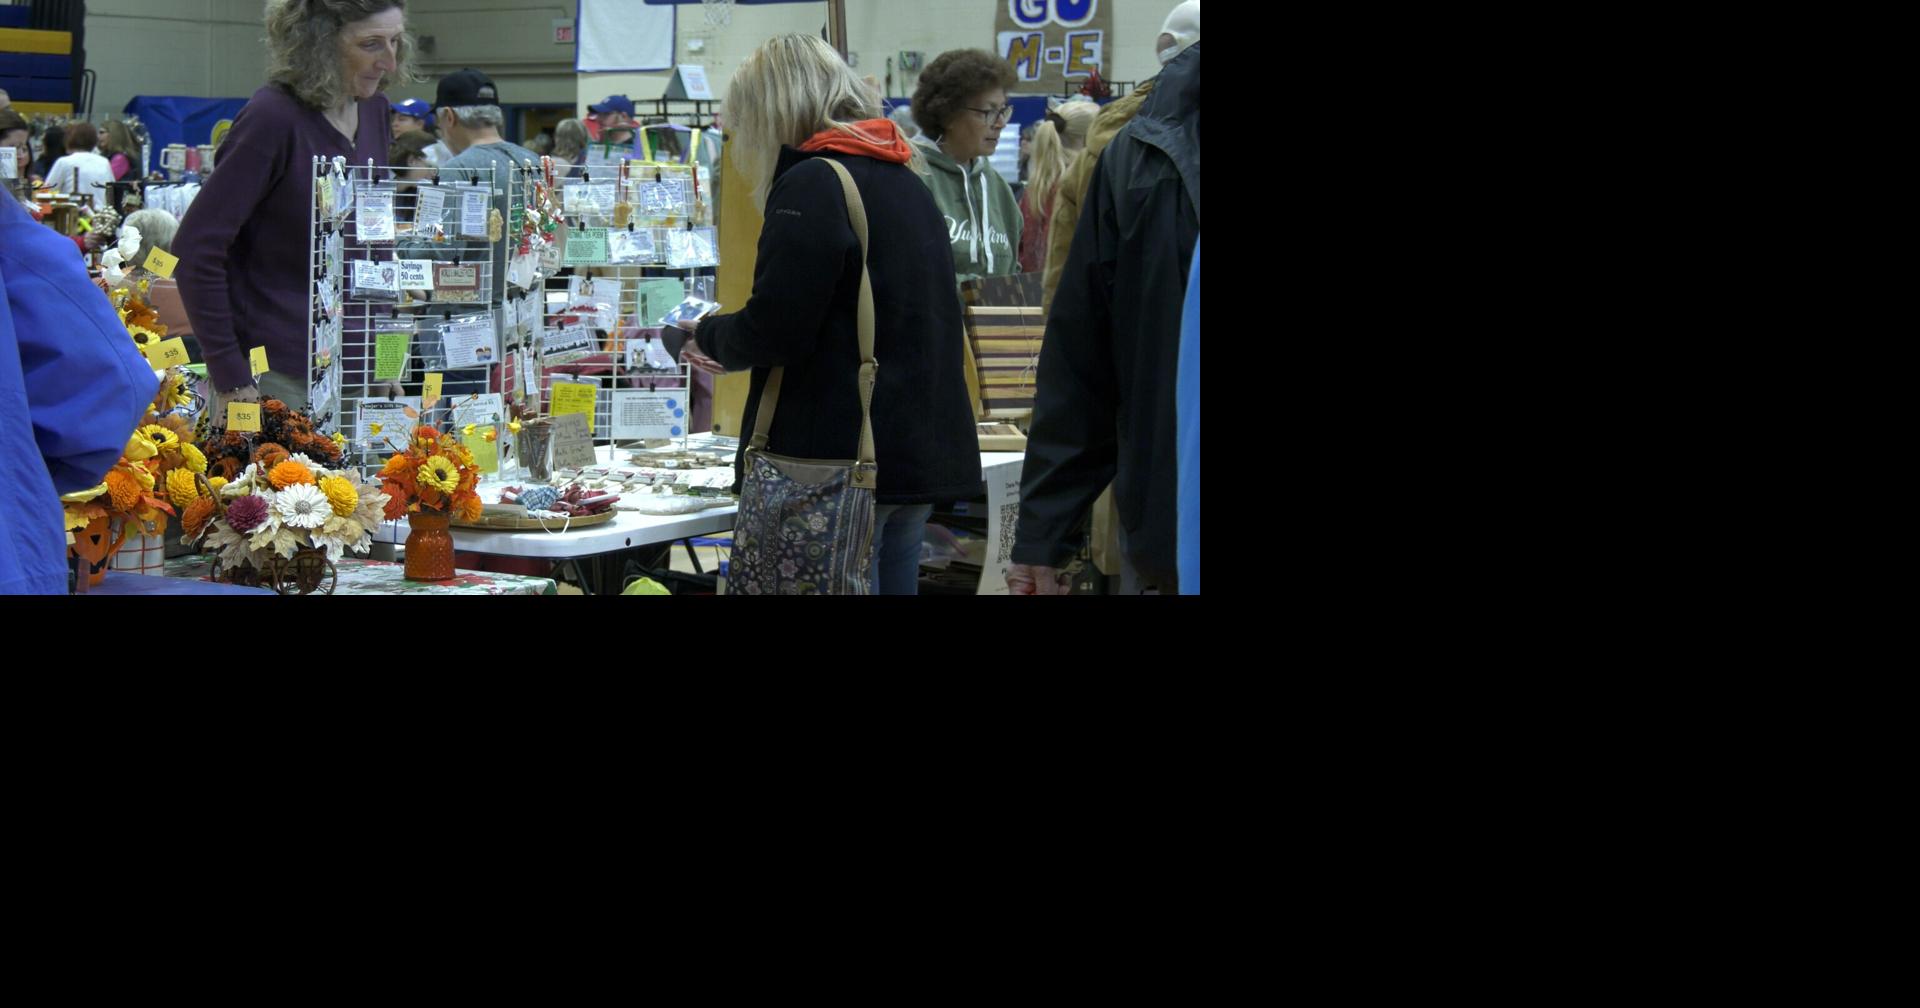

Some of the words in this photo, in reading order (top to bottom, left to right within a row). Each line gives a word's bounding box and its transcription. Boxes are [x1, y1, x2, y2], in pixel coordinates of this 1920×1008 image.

[1005, 32, 1100, 79] M-E
[400, 261, 423, 272] Sayings
[401, 271, 409, 281] 50
[409, 273, 425, 281] cents
[164, 348, 179, 359] $35
[236, 412, 252, 421] $35
